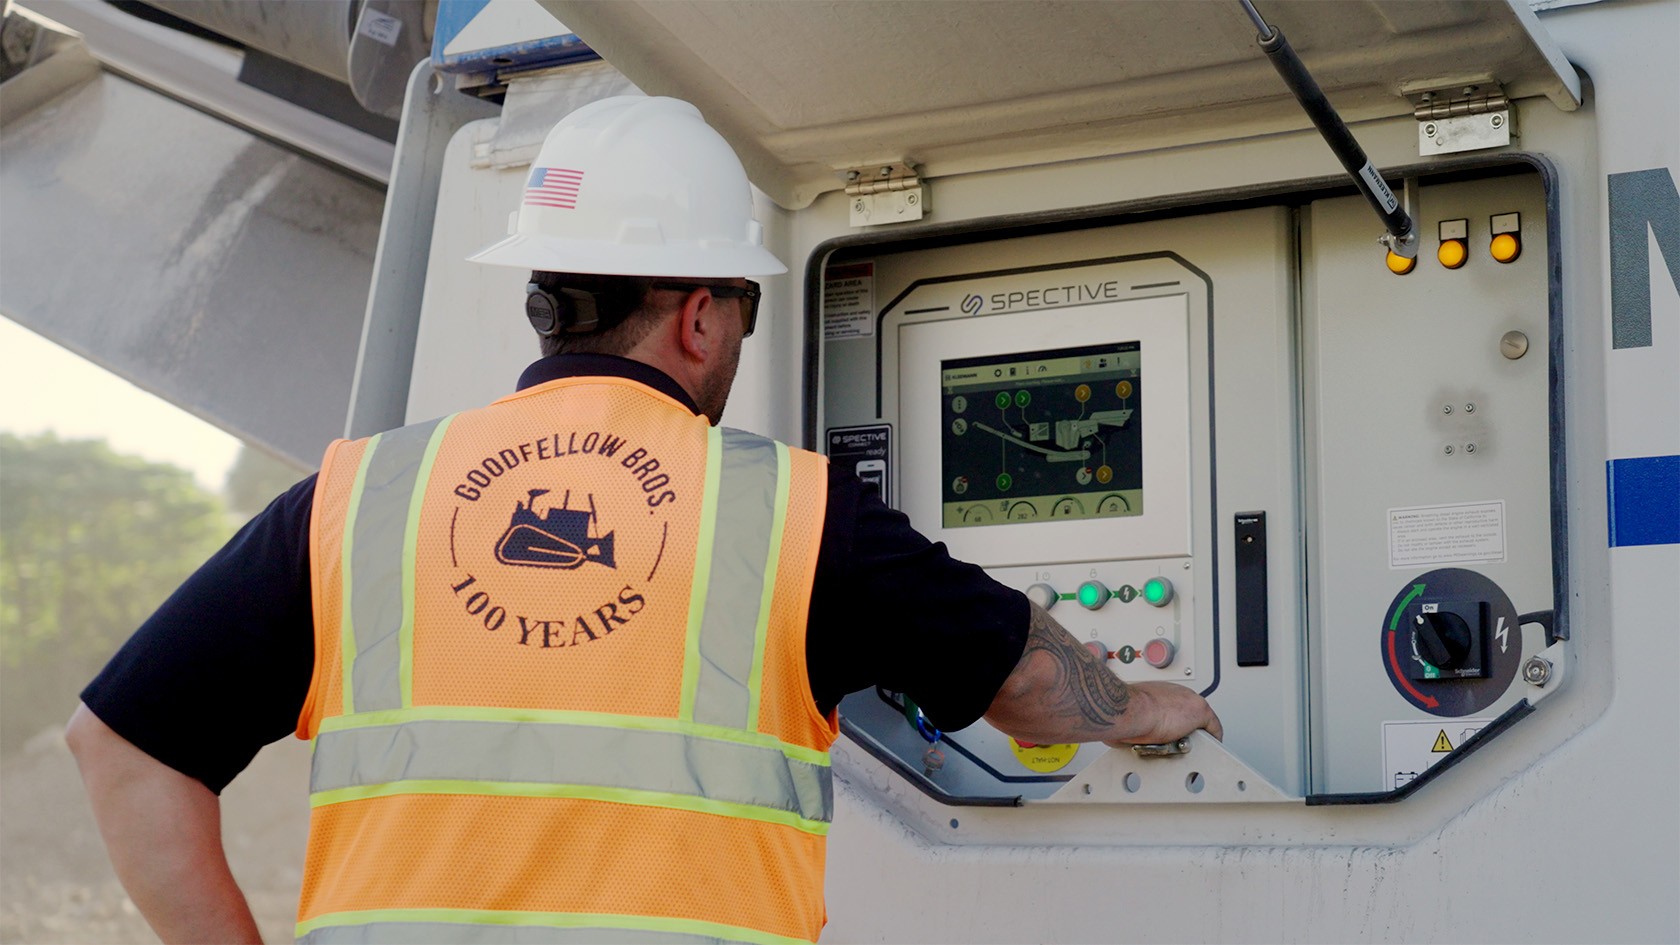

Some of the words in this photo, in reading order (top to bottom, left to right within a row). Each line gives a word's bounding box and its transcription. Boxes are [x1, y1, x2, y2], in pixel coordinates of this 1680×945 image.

[844, 279, 862, 287] AREA
[991, 281, 1118, 311] SPECTIVE
[842, 432, 887, 443] SPECTIVE
[865, 447, 887, 457] ready
[454, 431, 628, 502] GOODFELLOW
[621, 446, 676, 515] BROS.
[450, 573, 507, 632] 100
[516, 584, 646, 649] YEARS
